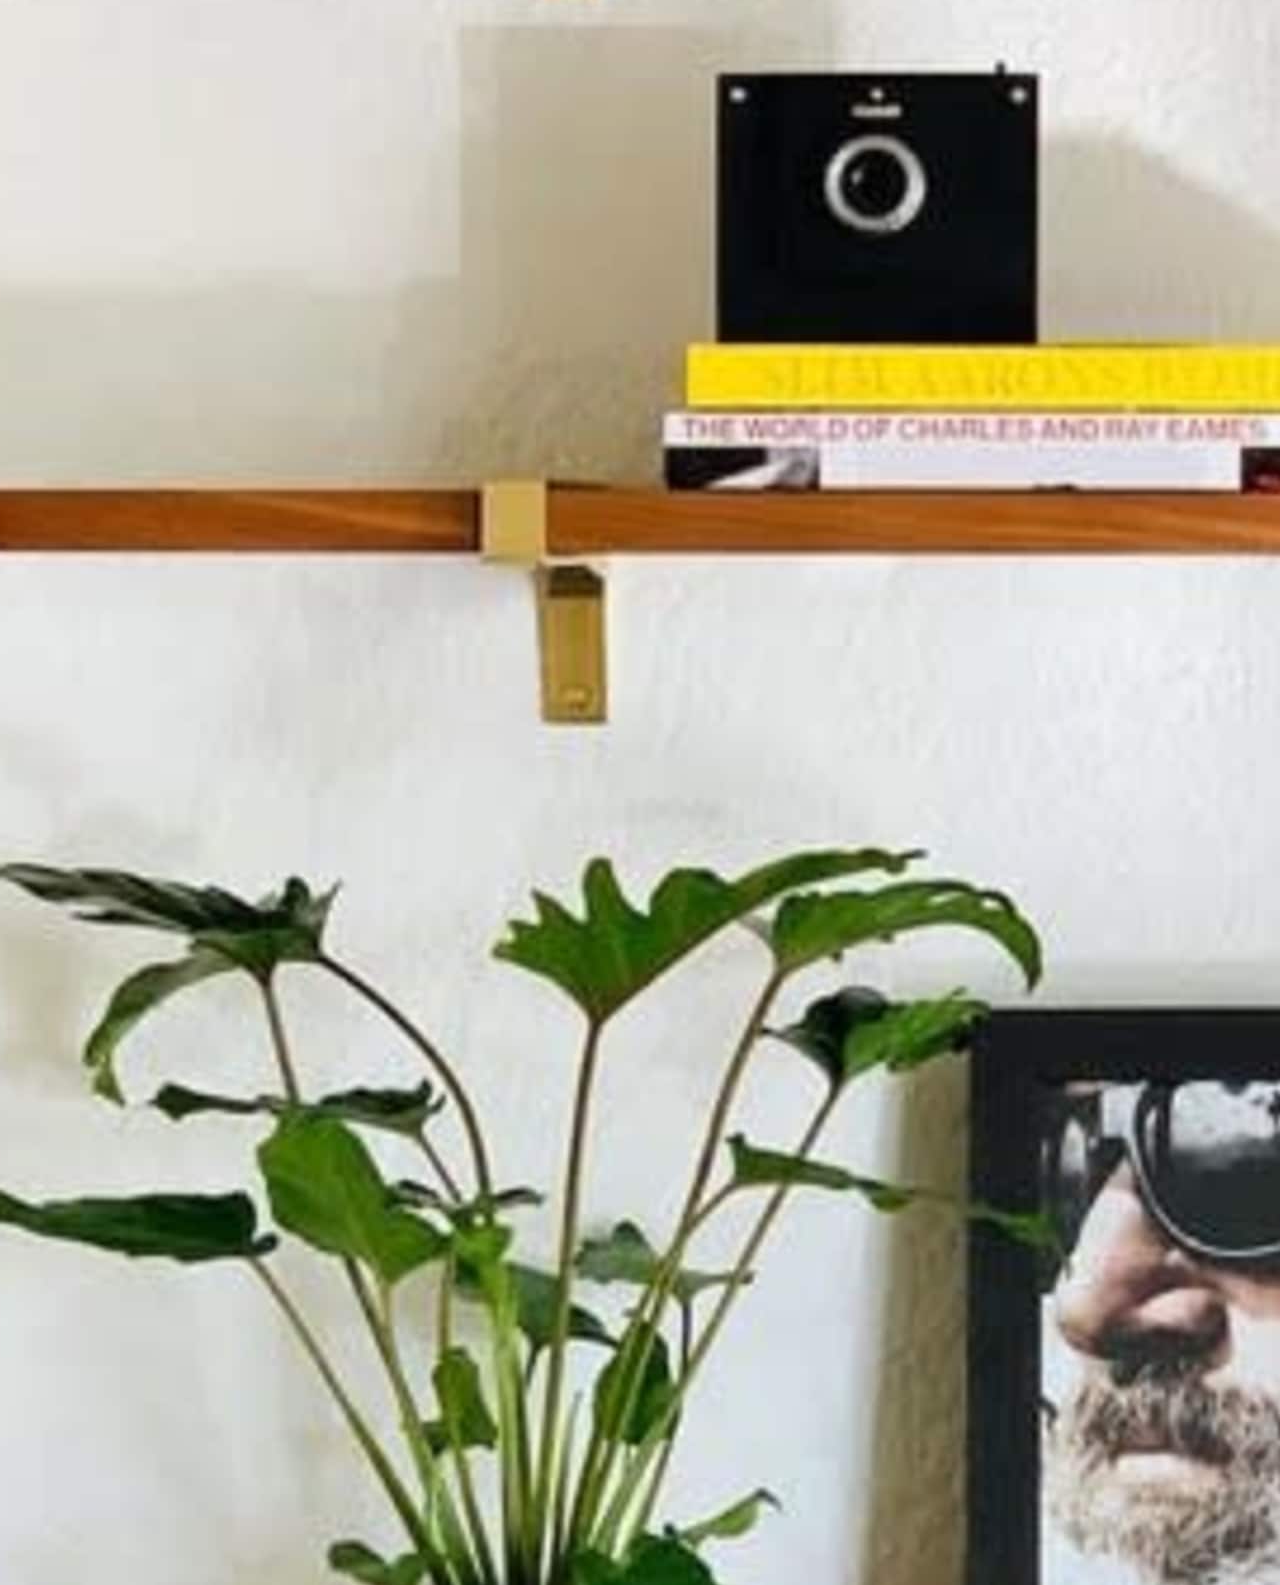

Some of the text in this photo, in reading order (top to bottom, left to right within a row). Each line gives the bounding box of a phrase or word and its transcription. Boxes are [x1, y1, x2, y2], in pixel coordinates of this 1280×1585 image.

[684, 418, 1267, 441] THE WORLD OF CHARLES AND RAY EAMES
